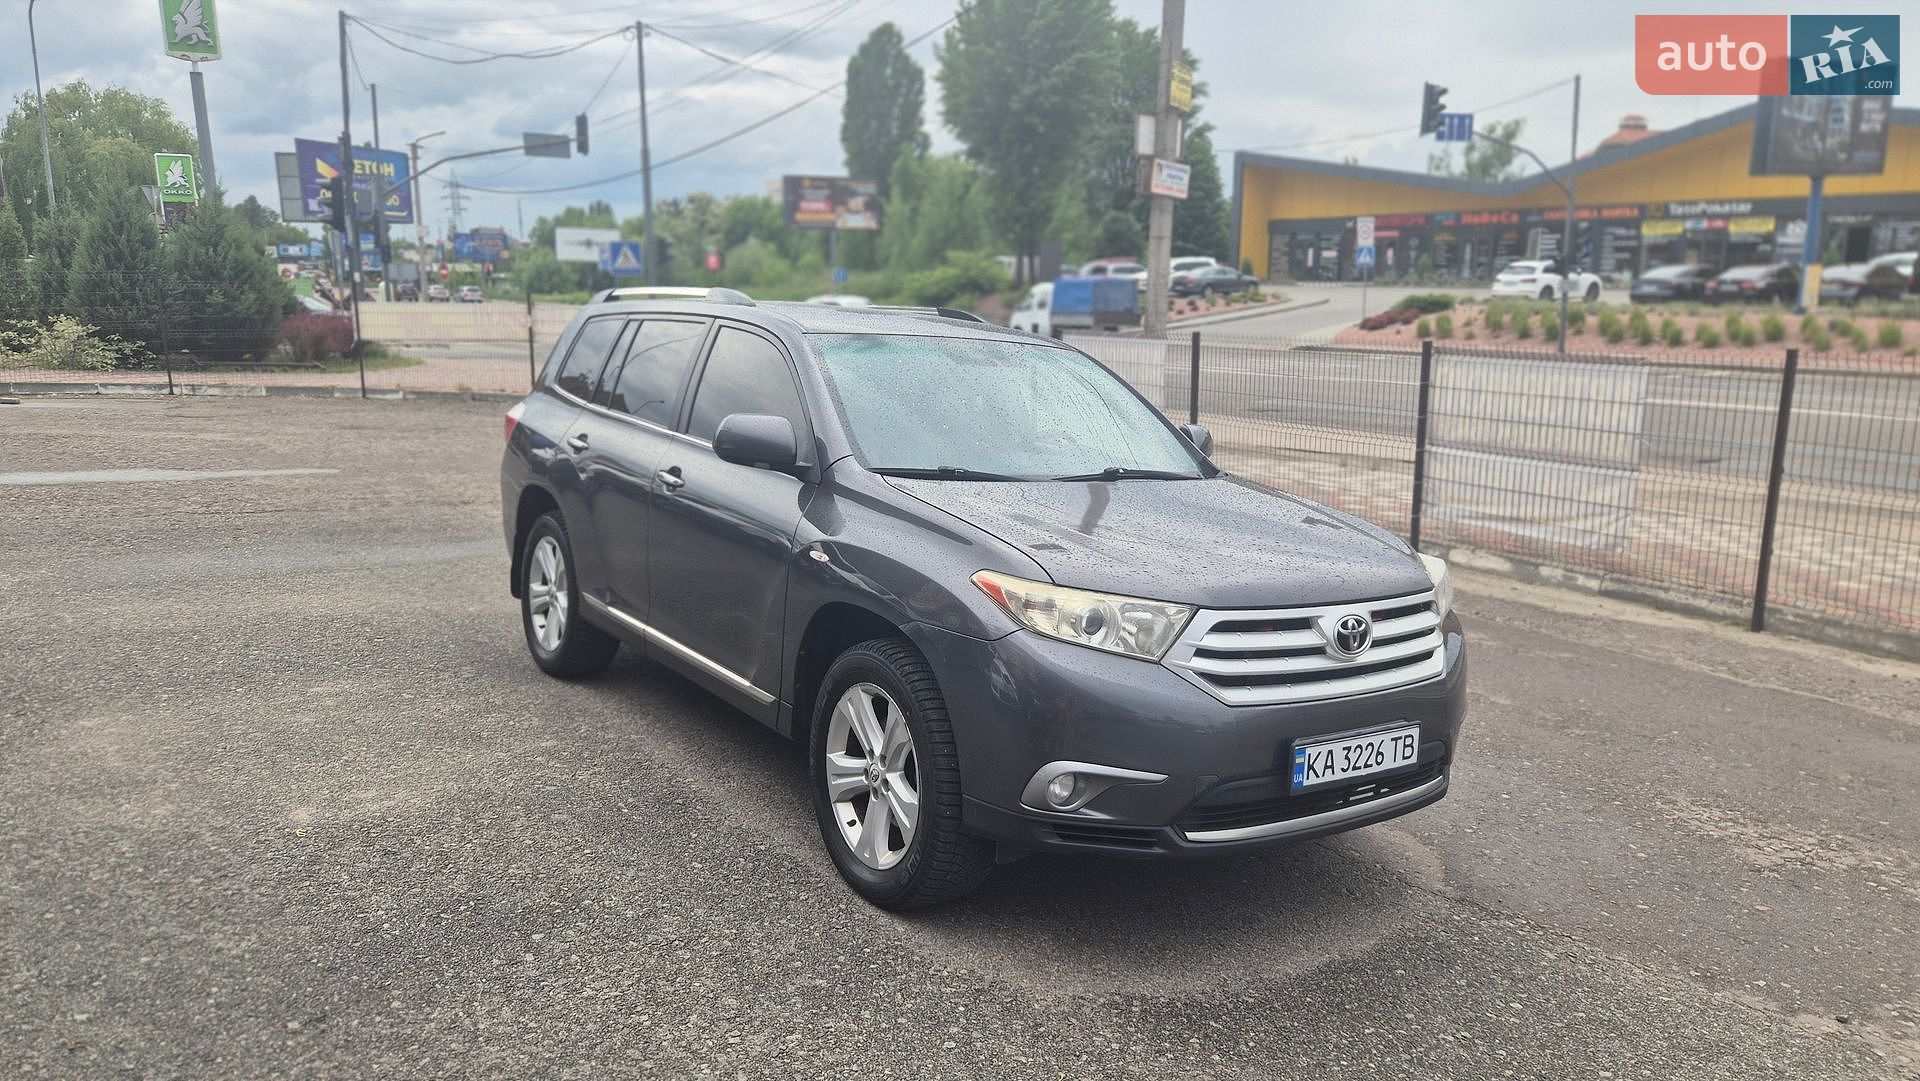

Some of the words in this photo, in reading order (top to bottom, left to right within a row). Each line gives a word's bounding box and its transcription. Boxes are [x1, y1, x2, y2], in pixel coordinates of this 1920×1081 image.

[351, 158, 396, 177] ЕТОН
[1306, 749, 1335, 780] KA
[1340, 739, 1385, 773] 3226
[1390, 733, 1415, 763] TB
[1293, 774, 1303, 785] UA
